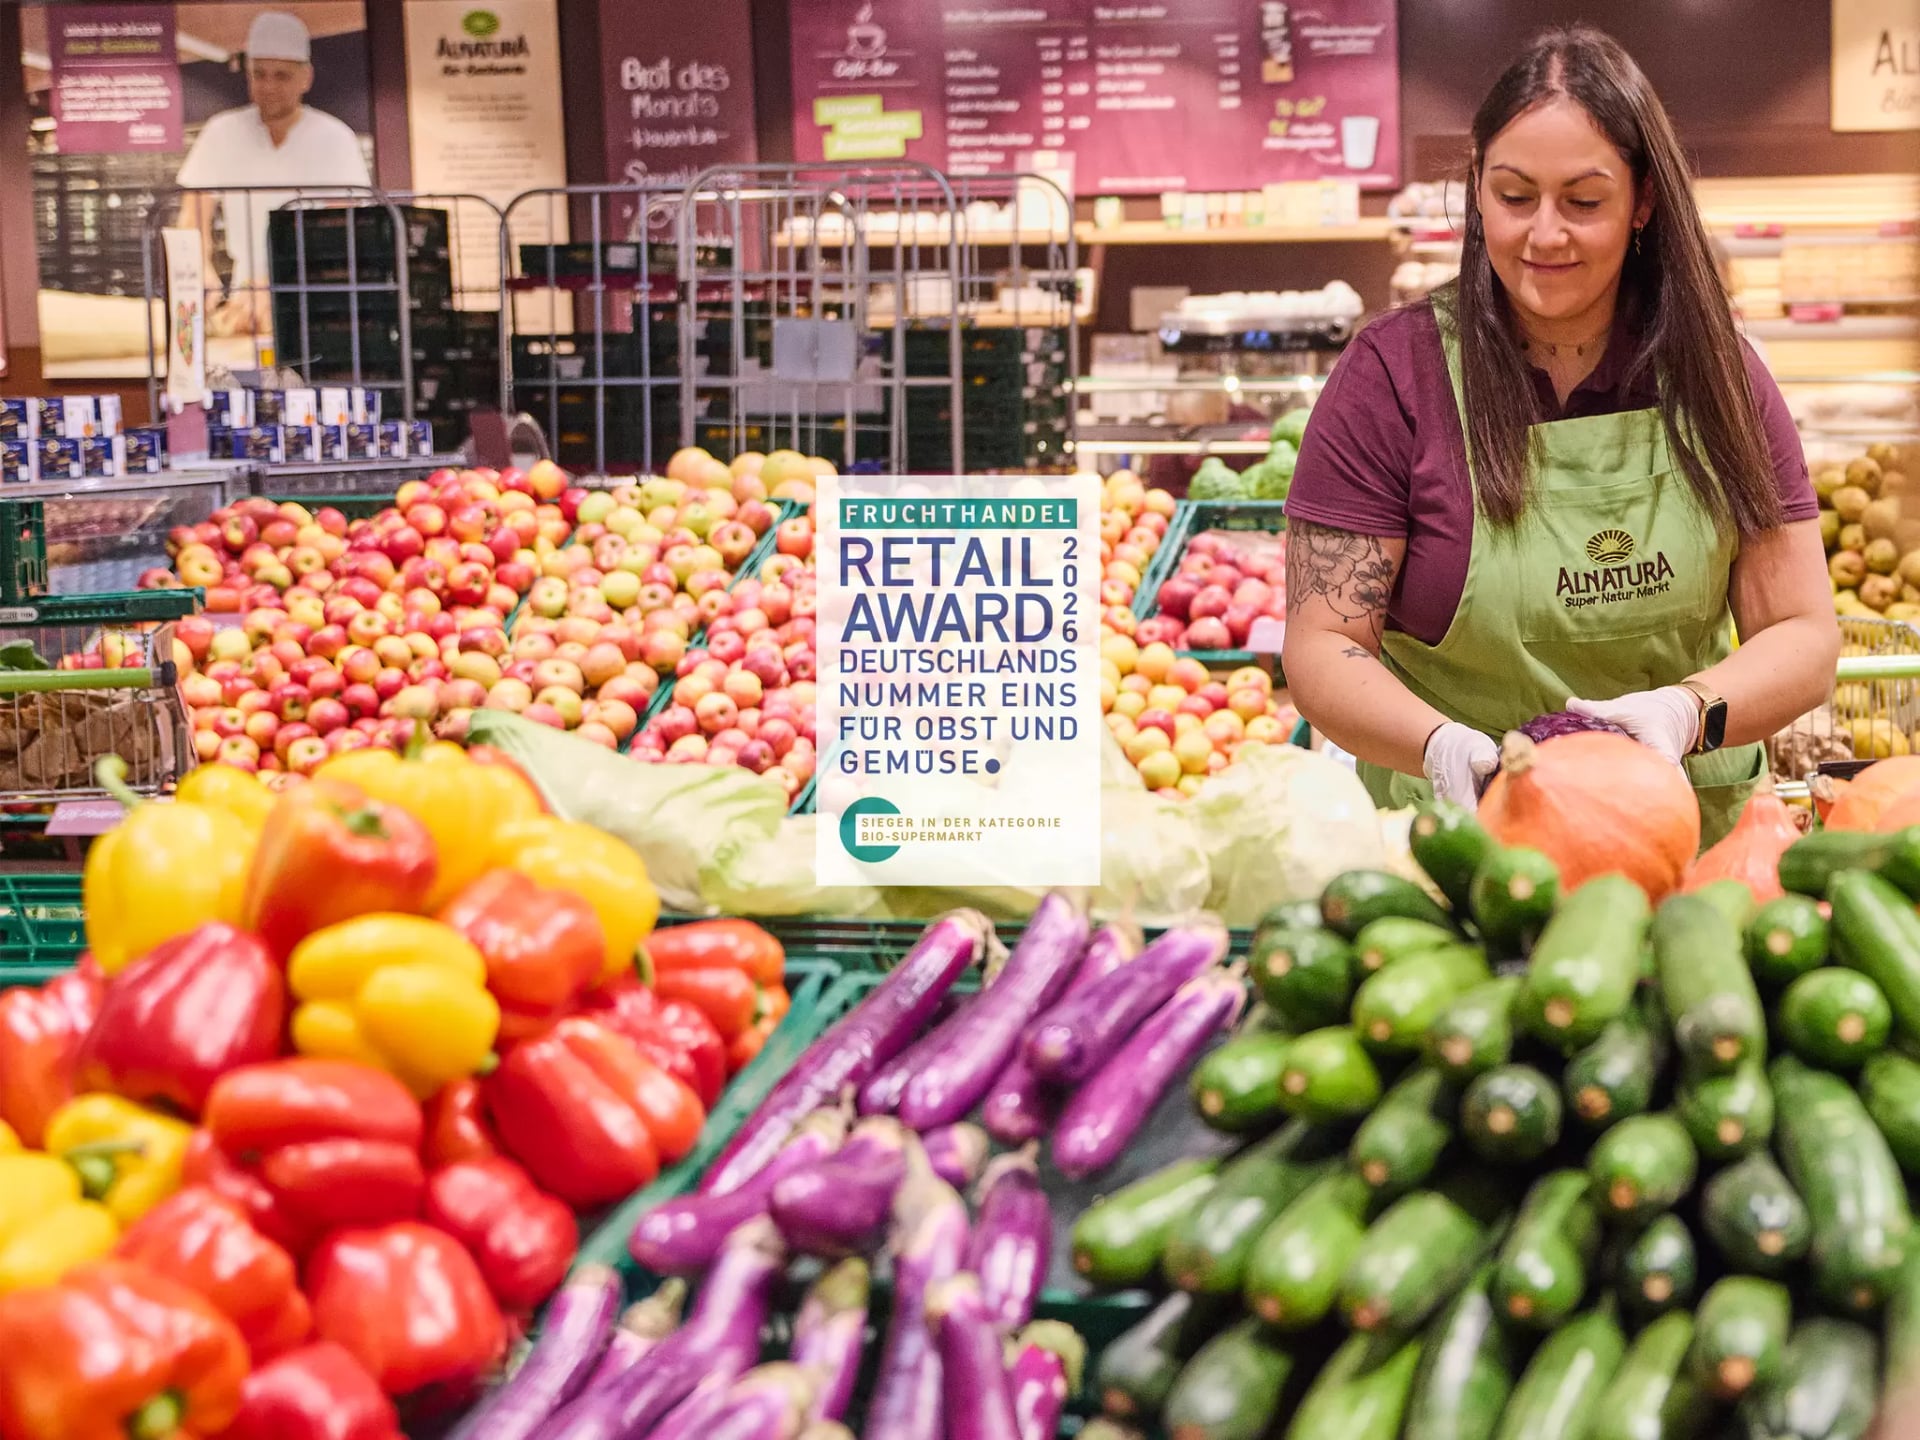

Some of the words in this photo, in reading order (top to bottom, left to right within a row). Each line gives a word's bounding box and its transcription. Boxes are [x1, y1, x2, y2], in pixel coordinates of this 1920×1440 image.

[1871, 29, 1920, 77] AL
[621, 56, 671, 90] Brot
[677, 61, 730, 92] des
[1556, 551, 1675, 596] ALNATURA
[1601, 590, 1635, 604] Natur
[1637, 581, 1670, 598] Markt
